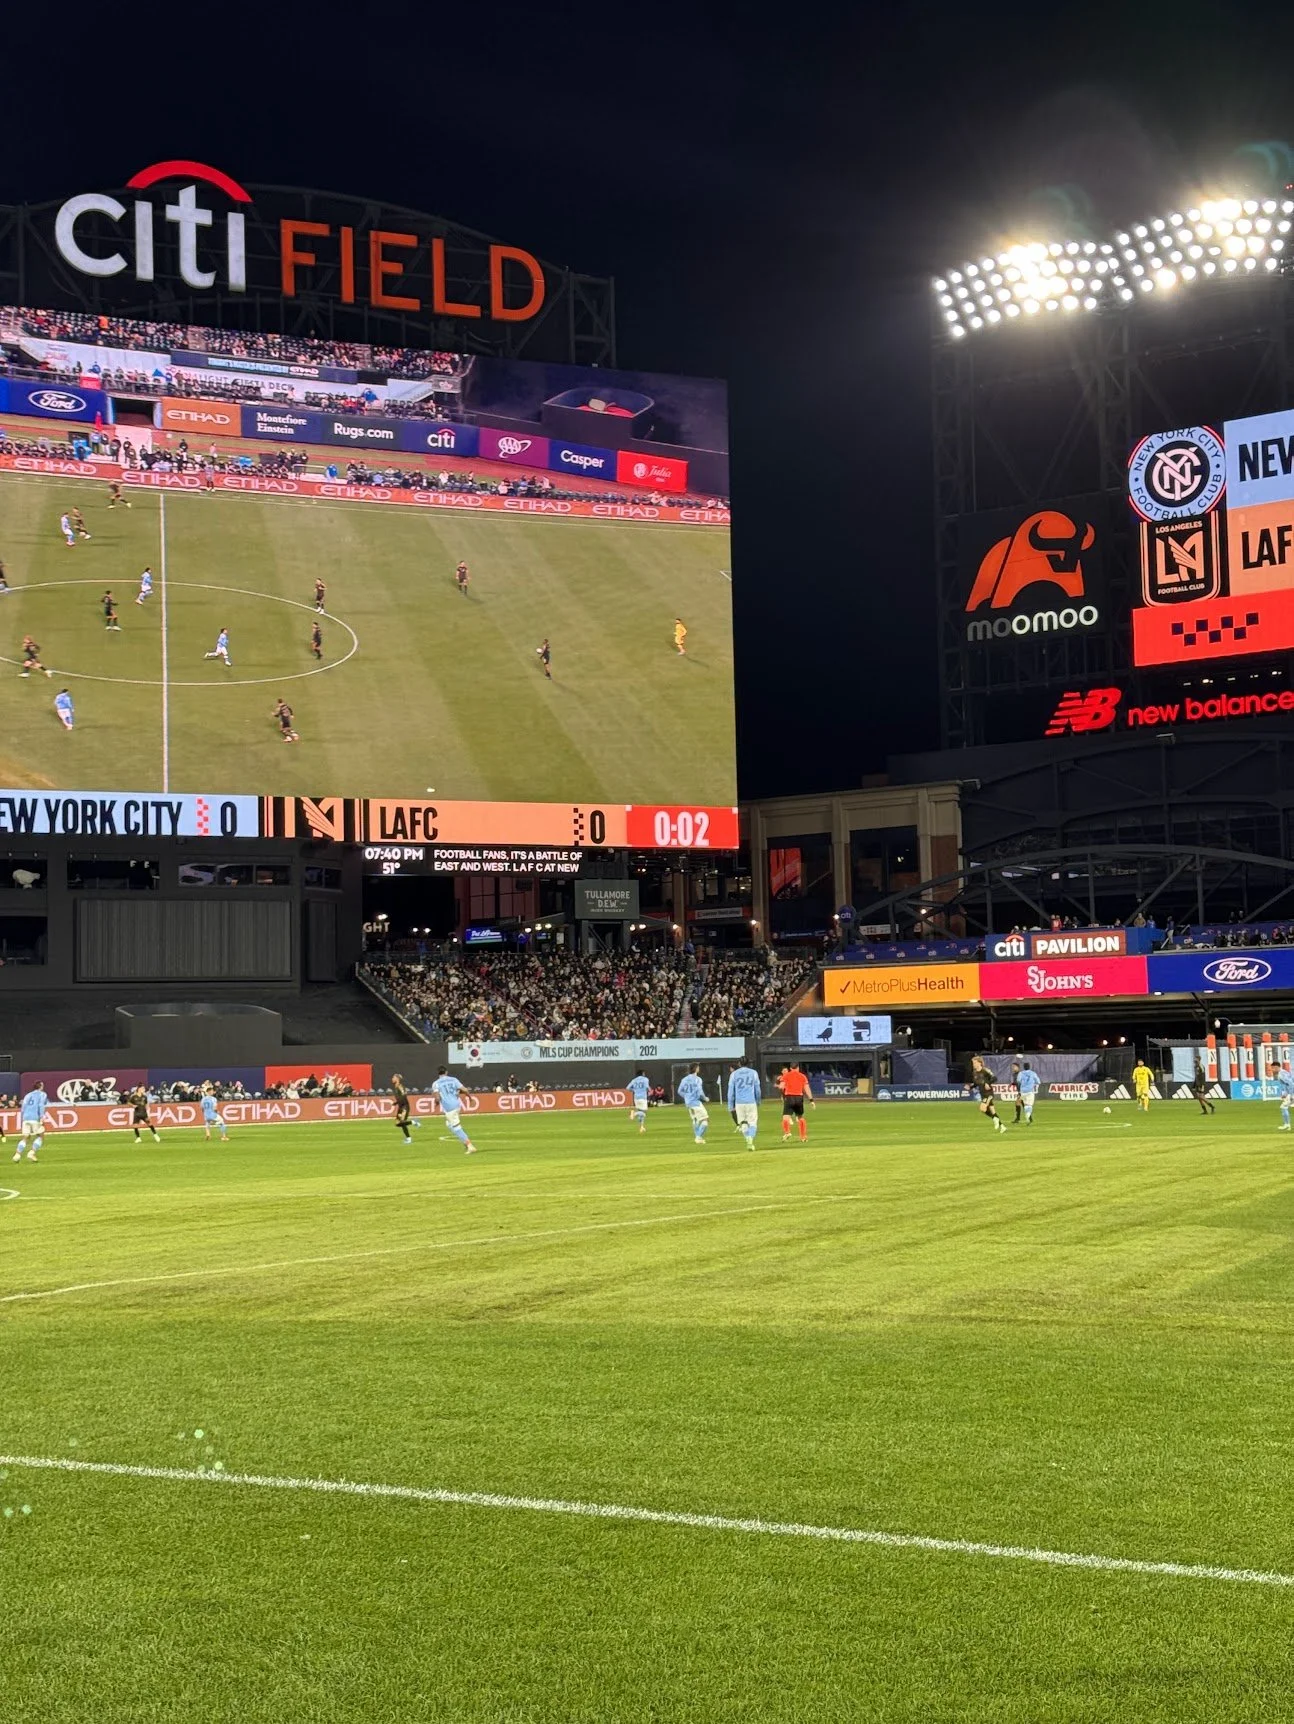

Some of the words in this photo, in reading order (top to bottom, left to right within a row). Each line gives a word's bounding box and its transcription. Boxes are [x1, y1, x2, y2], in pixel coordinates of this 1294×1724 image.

[55, 185, 247, 293] citi
[280, 218, 545, 323] FIELD
[40, 393, 76, 410] Ford
[166, 409, 231, 425] ETIHAD
[256, 412, 307, 426] Montefiore
[257, 423, 295, 435] Einstein
[334, 422, 394, 440] Rugs.com
[427, 432, 455, 449] citi
[1136, 442, 1154, 471] NEW
[1158, 428, 1197, 443] YORK
[1198, 433, 1221, 459] CITY
[14, 456, 97, 476] ETIHAD
[560, 449, 605, 469] Casper
[122, 471, 201, 488] ETIHAD
[223, 474, 299, 493] ETIHAD
[320, 483, 393, 501] ETIHAD
[413, 490, 484, 507] ETIHAD
[1133, 487, 1197, 519] FOOTBALL
[1197, 474, 1222, 508] CLUB
[504, 498, 571, 513] ETIHAD
[592, 504, 660, 518] ETIHAD
[680, 509, 730, 522] ETIHA
[1156, 525, 1169, 534] LOS
[1170, 521, 1203, 532] ANGELES
[1241, 525, 1293, 570] LAF
[1158, 585, 1188, 595] FOOTBALL
[1189, 582, 1205, 591] CLUB
[966, 604, 1099, 642] moomoo
[1128, 703, 1180, 727] new
[1186, 690, 1294, 721] balance
[44, 798, 117, 835] YORK
[124, 800, 182, 837] CITY
[220, 802, 238, 837] 0
[380, 806, 438, 841] LAFC
[590, 810, 606, 844] 0
[654, 810, 709, 847] 0:02
[364, 847, 401, 860] 07:40
[404, 848, 423, 860] PM
[434, 849, 482, 859] FOOTBALL
[483, 850, 510, 861] FANS,
[510, 850, 527, 860] IT'S
[527, 851, 535, 860] A
[536, 851, 568, 861] BATTLE
[569, 852, 583, 861] OF
[382, 861, 401, 875] 51°
[434, 861, 460, 871] EAST
[460, 862, 481, 871] AND
[482, 862, 511, 872] WEST.
[543, 863, 556, 872] AT
[557, 863, 580, 873] NEW
[584, 890, 630, 899] TULLAMORE
[994, 939, 1024, 958] citi
[1037, 935, 1120, 955] PAVILION
[1214, 960, 1260, 981] Ford
[853, 976, 964, 994] MetroPlusHealth
[539, 1047, 557, 1058] MLS
[558, 1047, 573, 1058] CUP
[574, 1046, 619, 1058] CHAMPIONS
[640, 1045, 658, 1057] 2021
[907, 1089, 960, 1099] POWERWASH
[1050, 1083, 1098, 1092] AMERICA'S
[324, 1098, 396, 1117] ETIHAD
[416, 1095, 480, 1112] ETAD
[498, 1093, 556, 1111] ETIHAD
[572, 1092, 626, 1108] ETIHAD
[108, 1105, 196, 1127] ETHAD
[223, 1102, 301, 1121] ETIHAD
